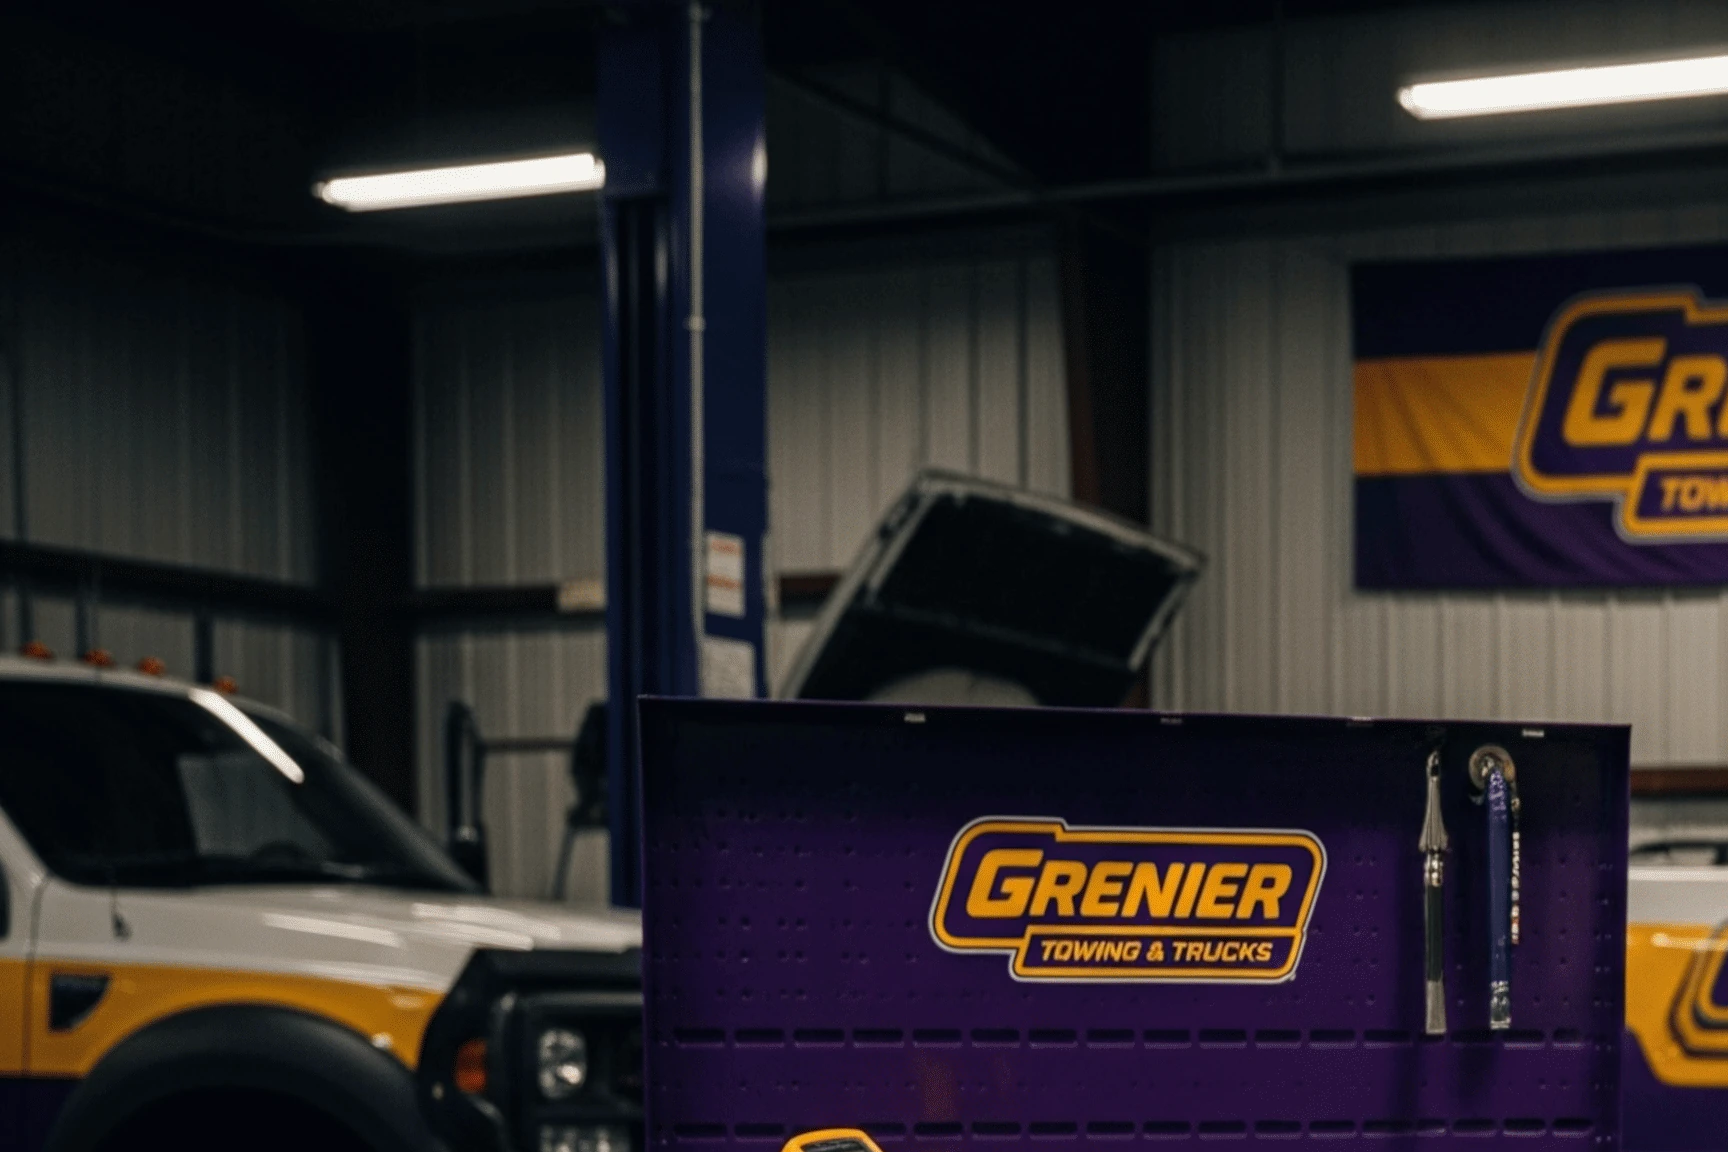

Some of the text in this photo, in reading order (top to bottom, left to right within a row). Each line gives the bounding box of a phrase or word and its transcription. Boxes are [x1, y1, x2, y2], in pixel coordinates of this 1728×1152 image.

[966, 848, 1293, 919] GRENIER
[1040, 940, 1274, 963] TOWING & TRUCKS
